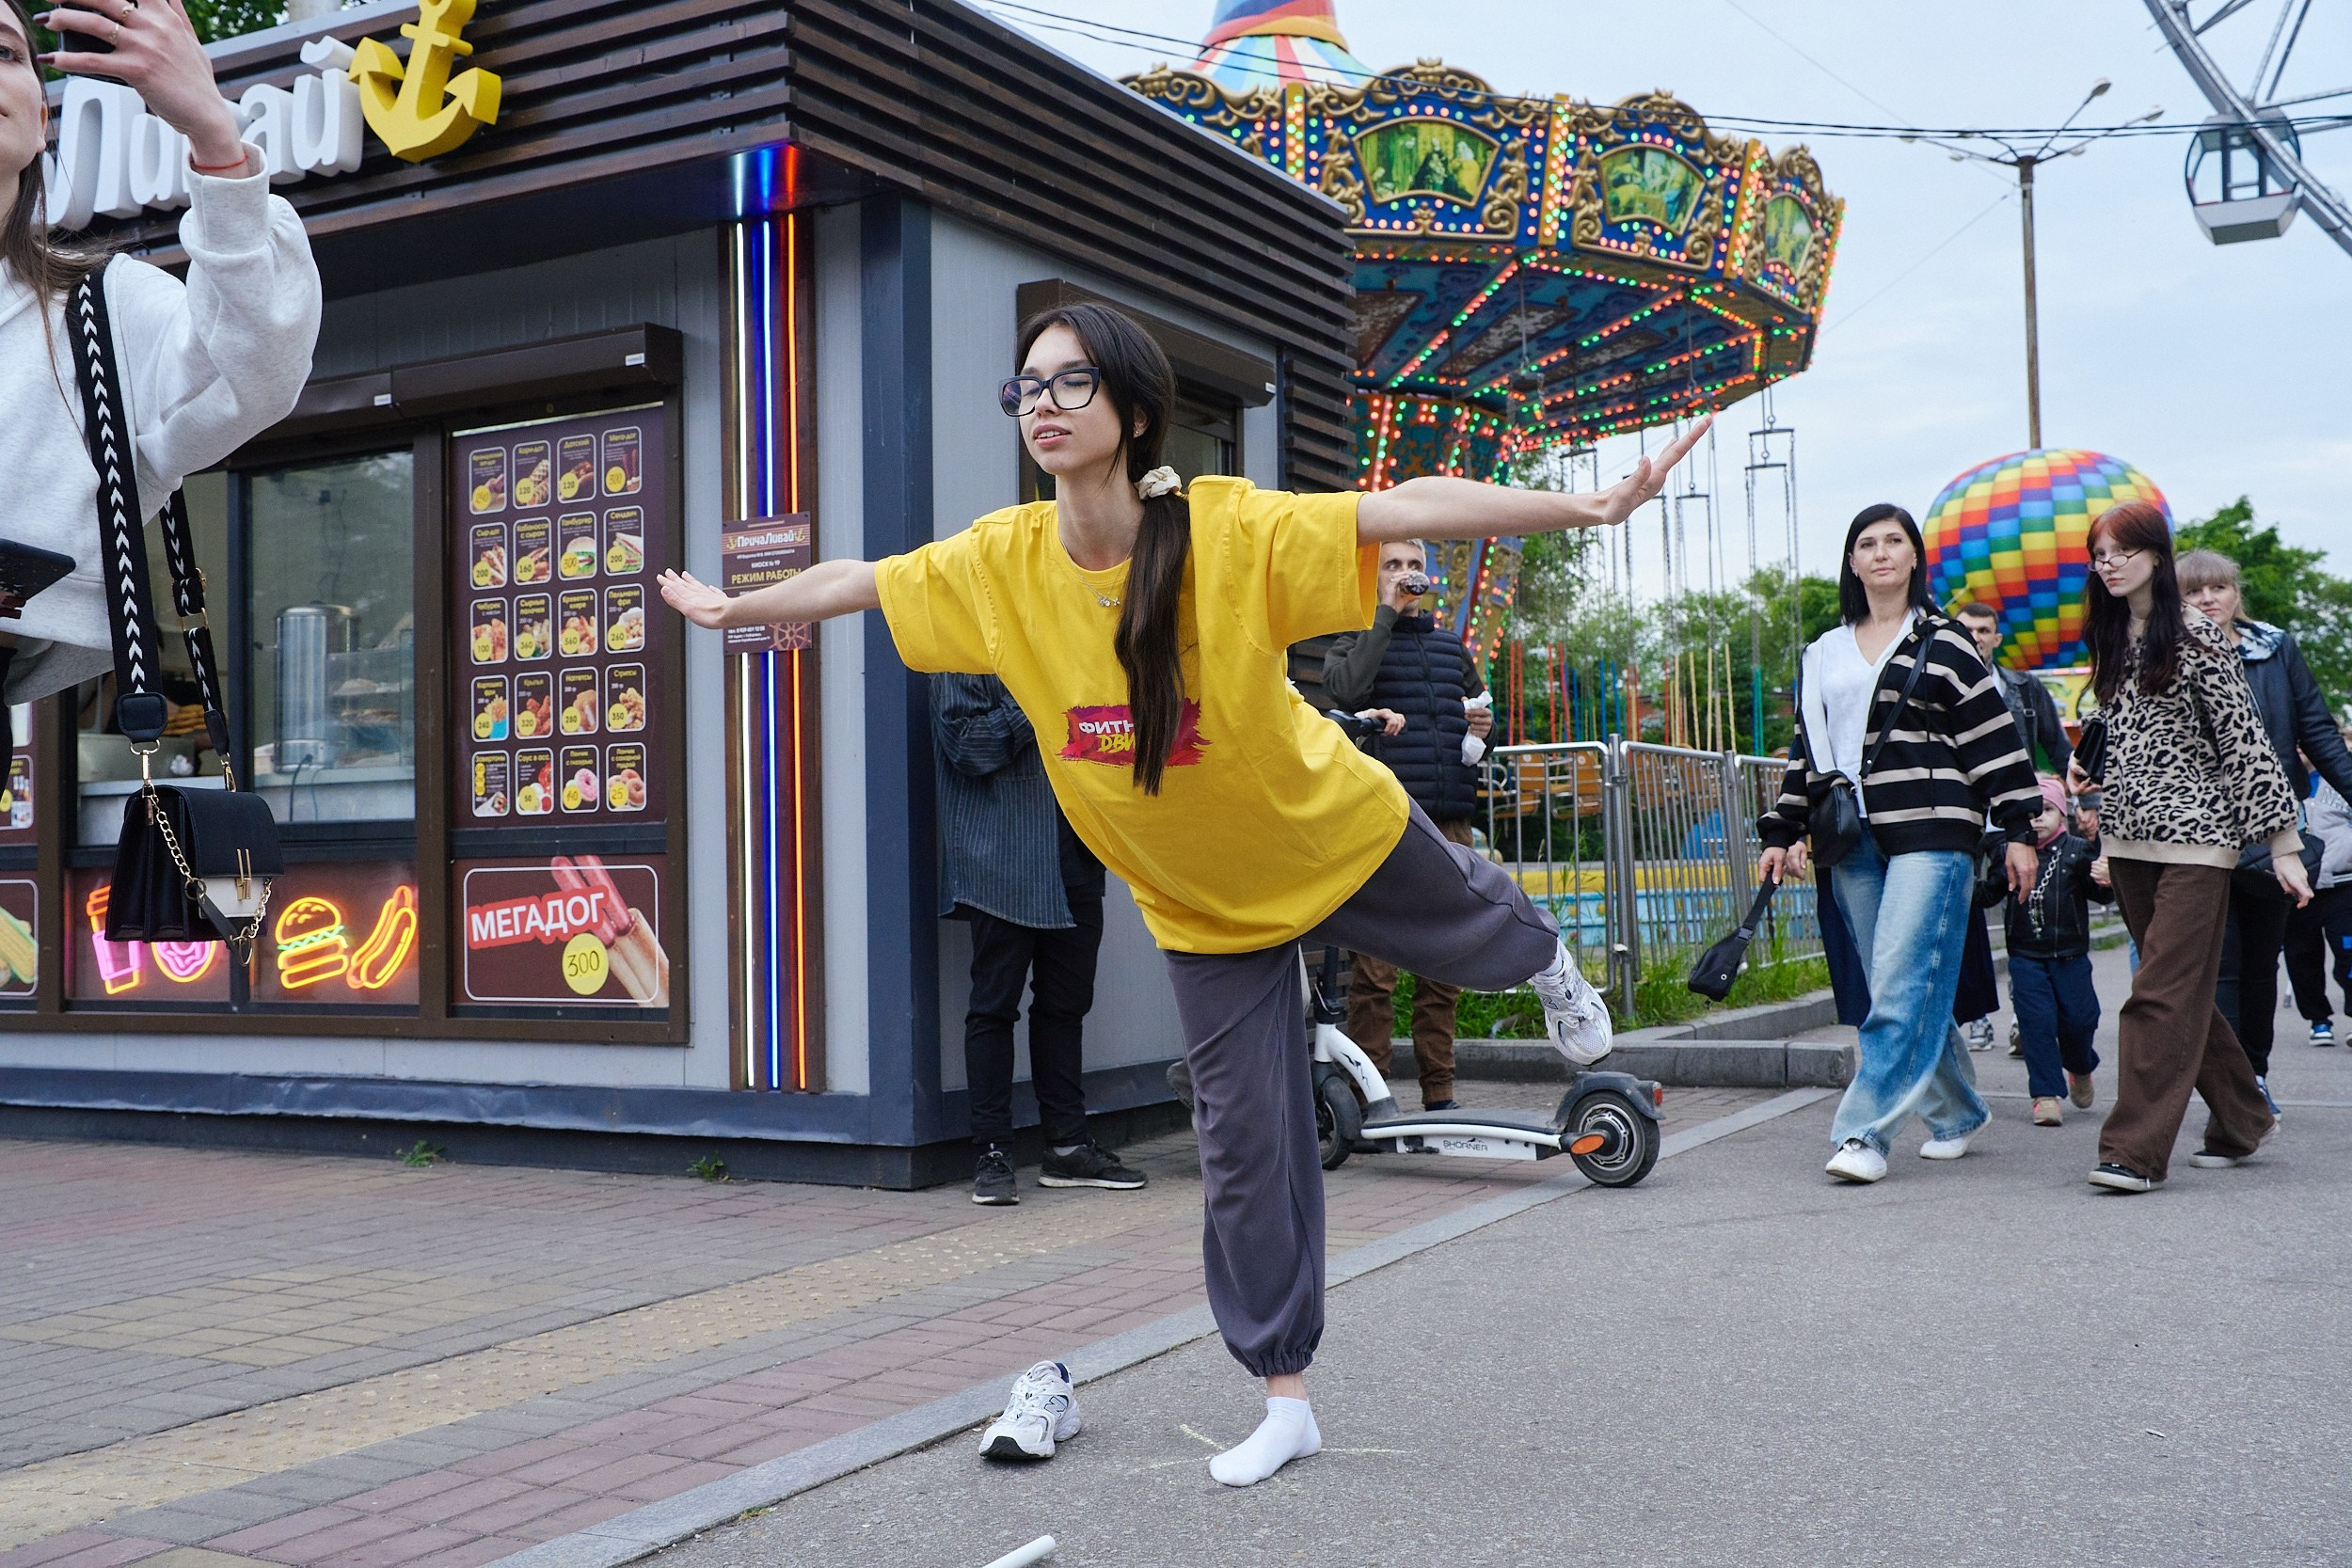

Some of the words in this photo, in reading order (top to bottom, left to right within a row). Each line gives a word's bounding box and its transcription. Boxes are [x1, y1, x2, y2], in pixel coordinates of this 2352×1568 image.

[564, 481, 575, 489] 120
[519, 486, 531, 495] 120
[737, 530, 794, 547] ПричаЛивай
[476, 568, 488, 578] 200
[519, 564, 532, 573] 160
[731, 572, 765, 584] РЕЖИМ
[564, 637, 578, 645] 560
[612, 632, 625, 641] 260
[477, 644, 489, 653] 100
[520, 641, 533, 649] 360
[565, 716, 578, 724] 280
[612, 712, 625, 721] 350
[478, 721, 490, 730] 240
[521, 720, 534, 728] 320
[612, 788, 624, 800] 25
[470, 893, 605, 942] МЕГАДОГ
[567, 950, 600, 977] 300
